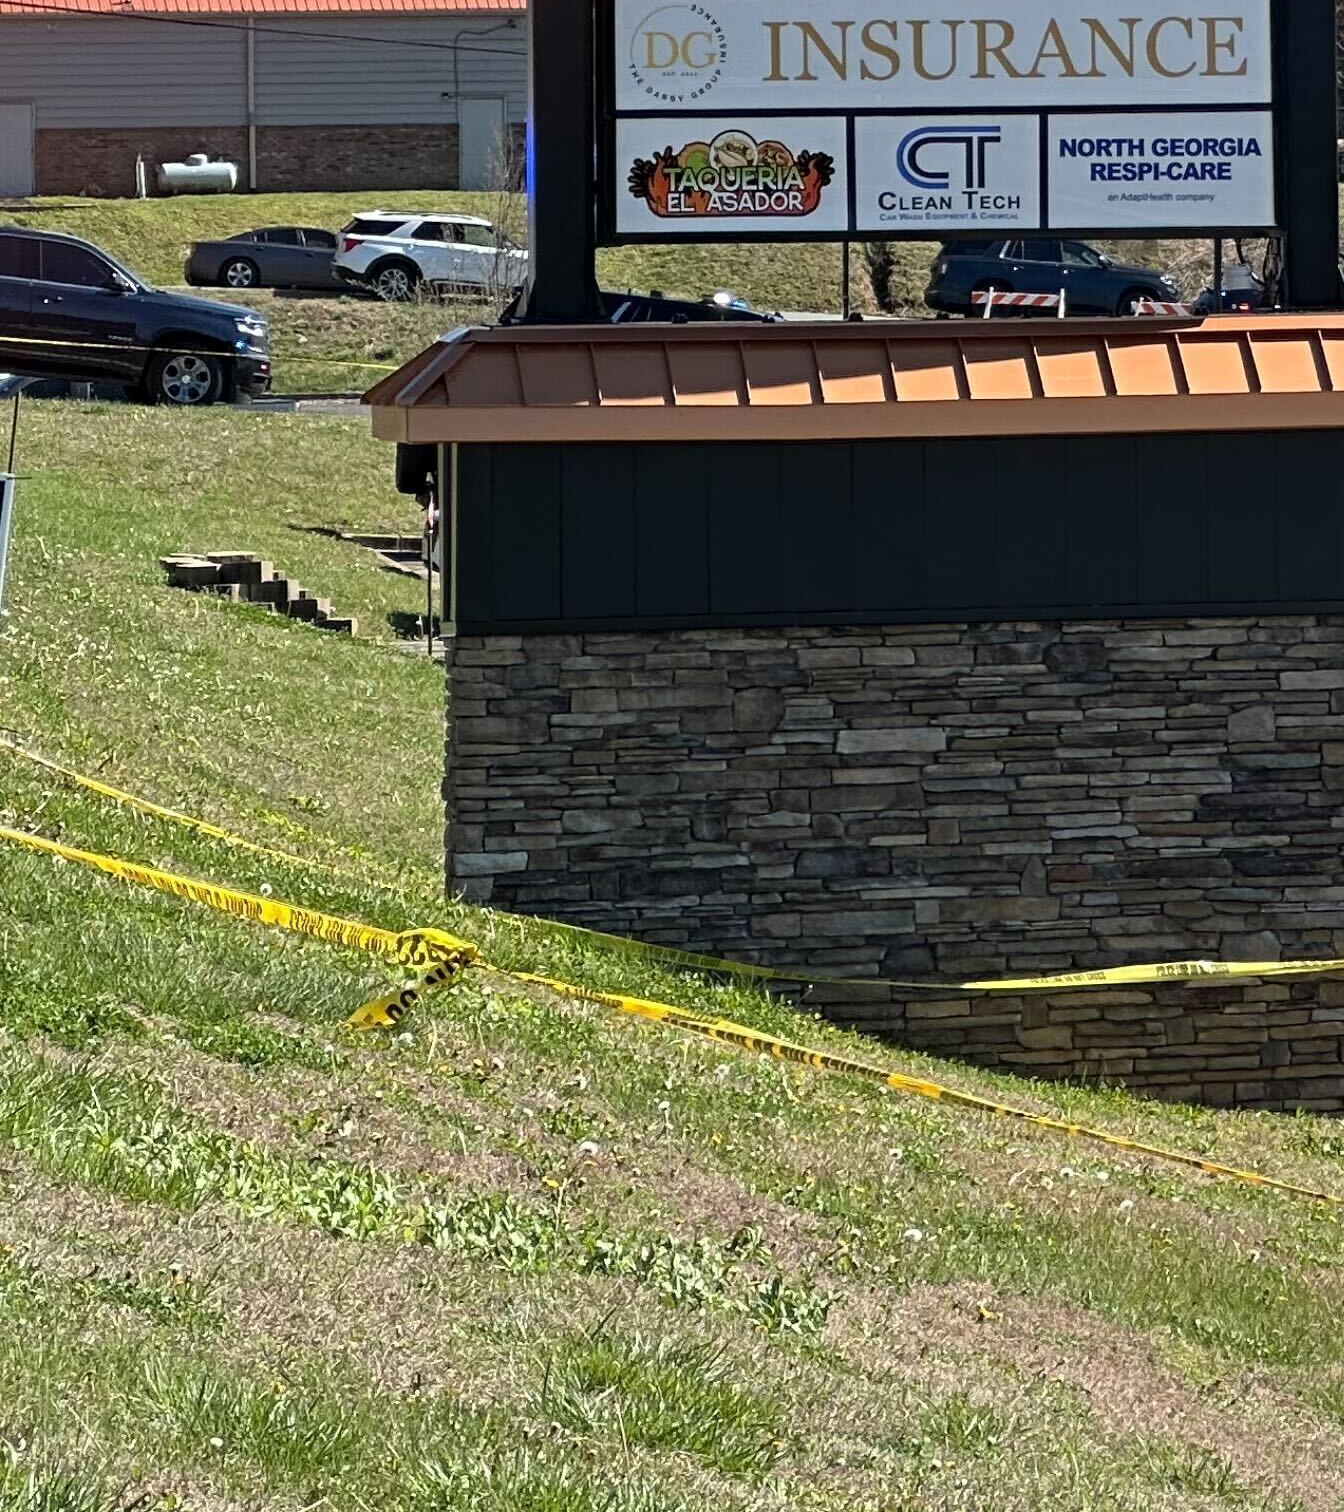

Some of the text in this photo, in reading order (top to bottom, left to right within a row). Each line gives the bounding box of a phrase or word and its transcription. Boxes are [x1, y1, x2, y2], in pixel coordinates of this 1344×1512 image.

[690, 4, 728, 64] INSURANCE
[643, 31, 717, 70] DG
[761, 16, 1249, 83] INSURANCE
[690, 68, 721, 99] GROUP
[896, 126, 1001, 189] CT
[1059, 137, 1262, 157] NORTH GEORGIA
[664, 167, 805, 193] TAQUERIA
[1090, 162, 1232, 181] RESPI-CARE
[667, 191, 804, 212] EL ASADOR
[878, 190, 1021, 211] CLEAN TECH
[1120, 192, 1173, 202] AdaptHealth
[1175, 193, 1215, 203] company
